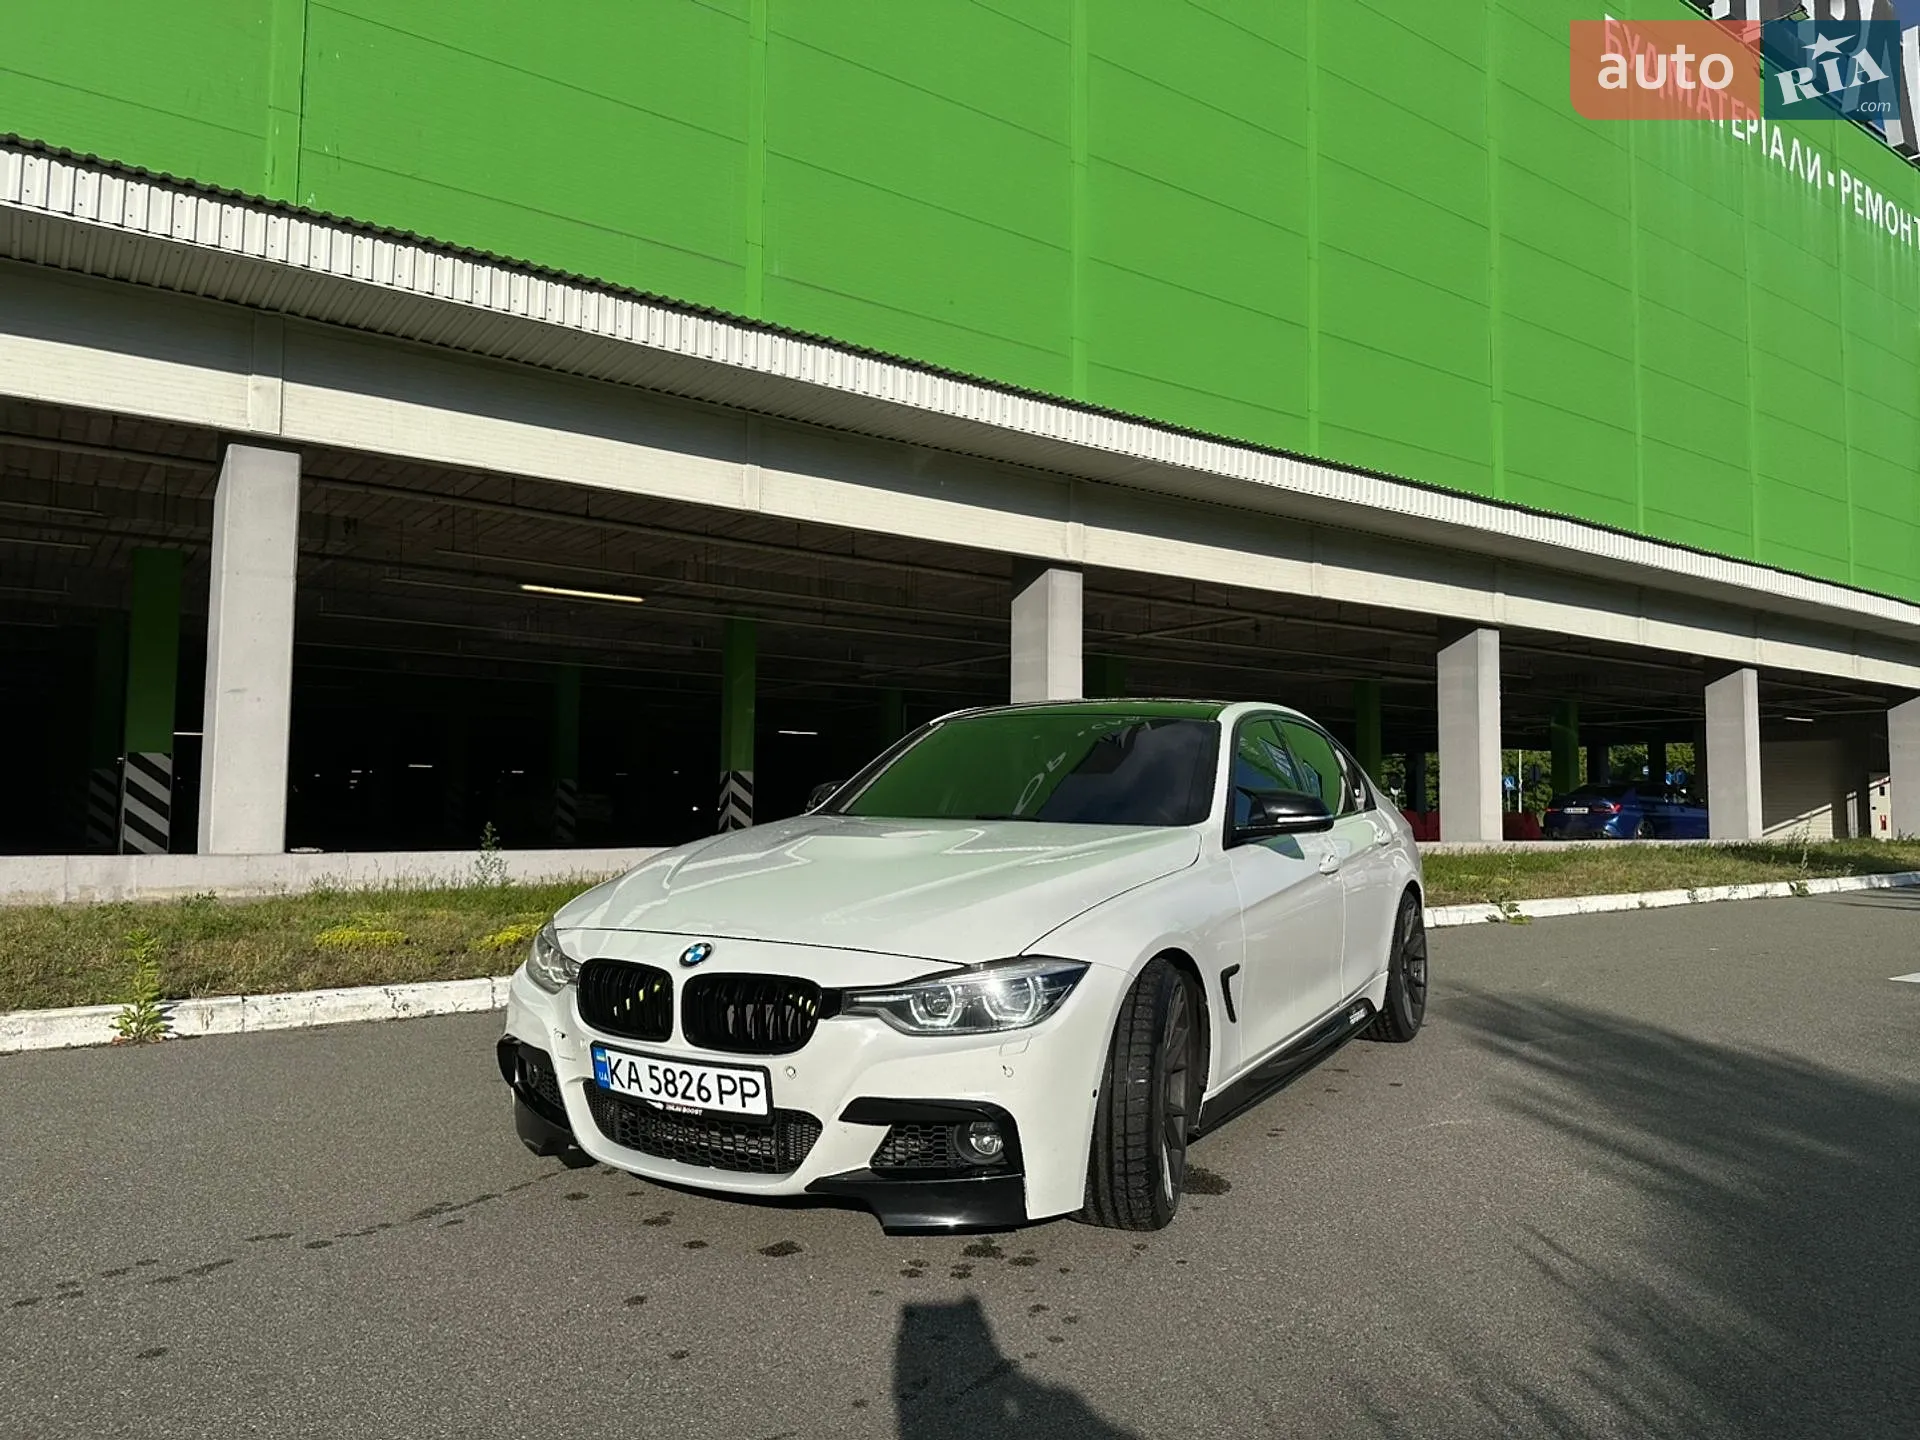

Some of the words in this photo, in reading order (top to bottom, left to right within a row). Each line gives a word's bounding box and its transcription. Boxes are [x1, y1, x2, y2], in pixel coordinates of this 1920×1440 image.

[607, 1055, 643, 1093] KA
[649, 1065, 711, 1103] 5826
[716, 1074, 760, 1108] PP
